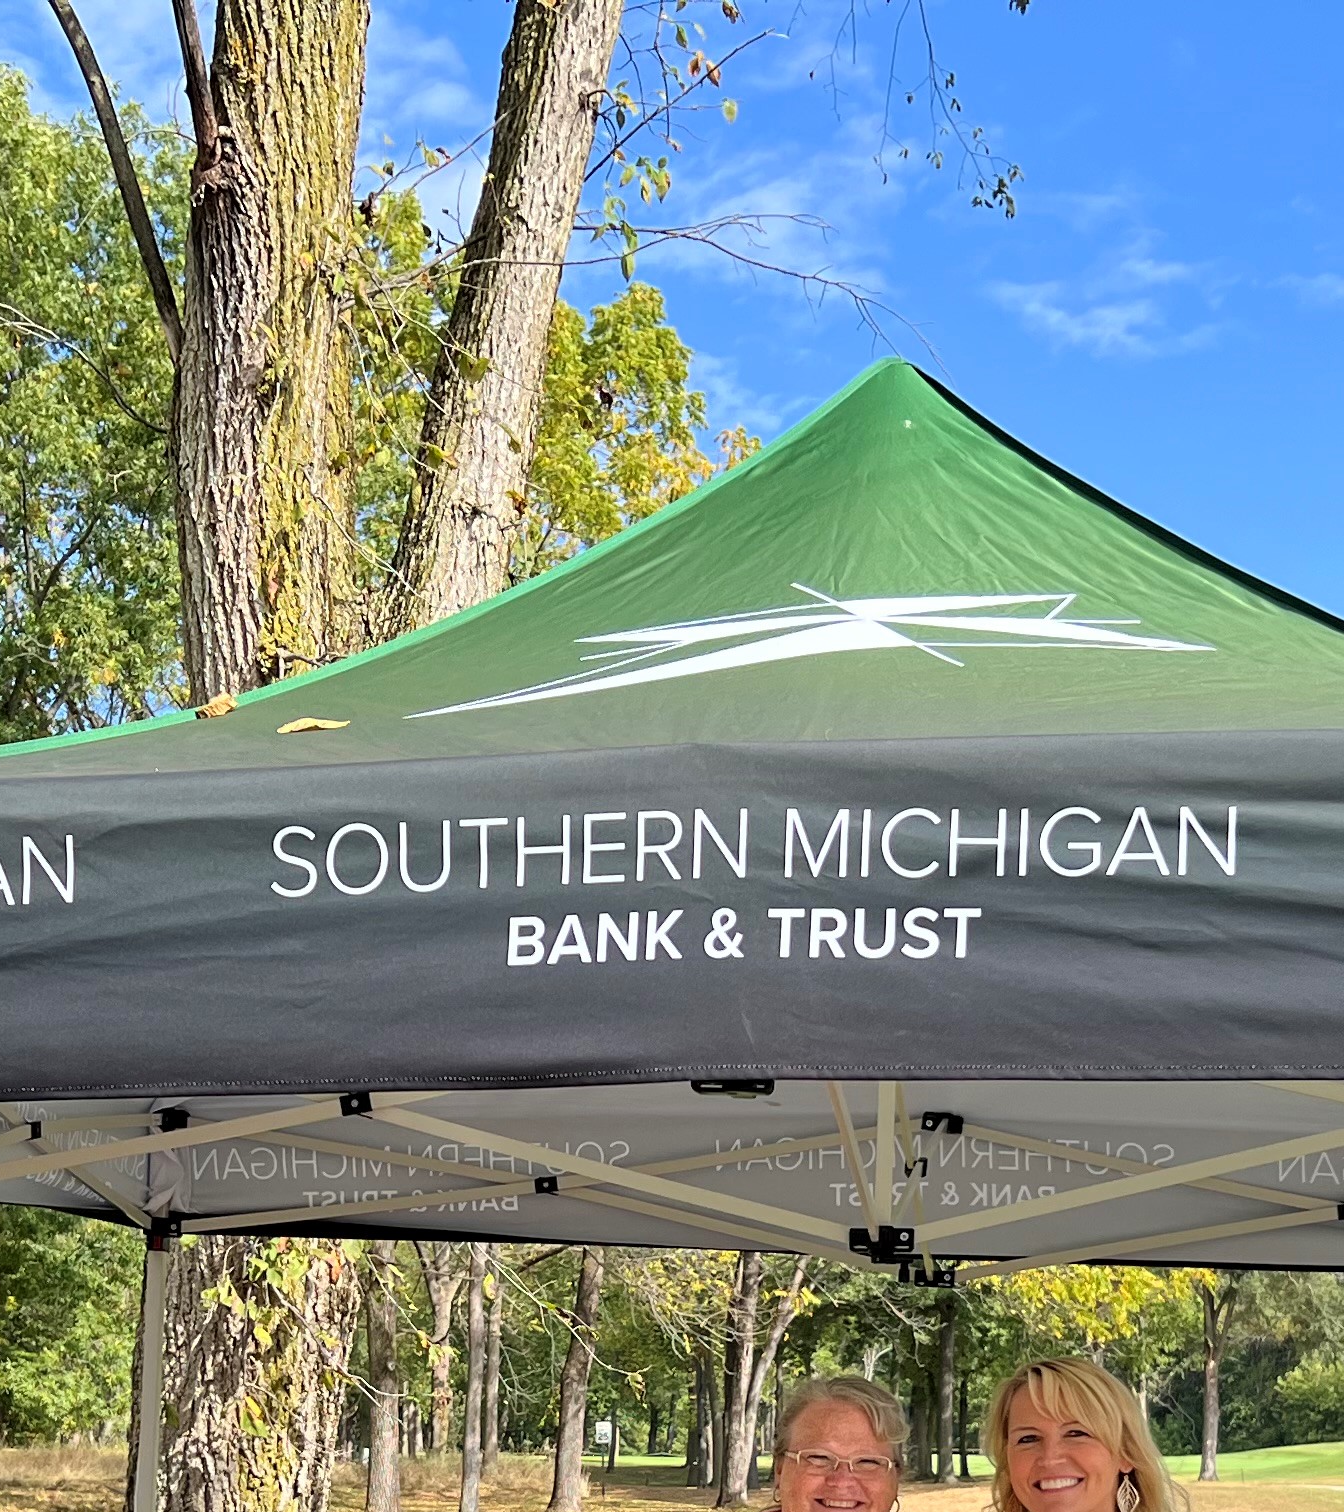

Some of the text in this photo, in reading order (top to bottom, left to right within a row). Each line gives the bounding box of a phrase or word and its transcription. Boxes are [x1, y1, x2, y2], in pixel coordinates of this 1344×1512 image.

[269, 804, 1239, 899] SOUTHERN MICHIGAN
[505, 905, 982, 968] BANK & TRUST
